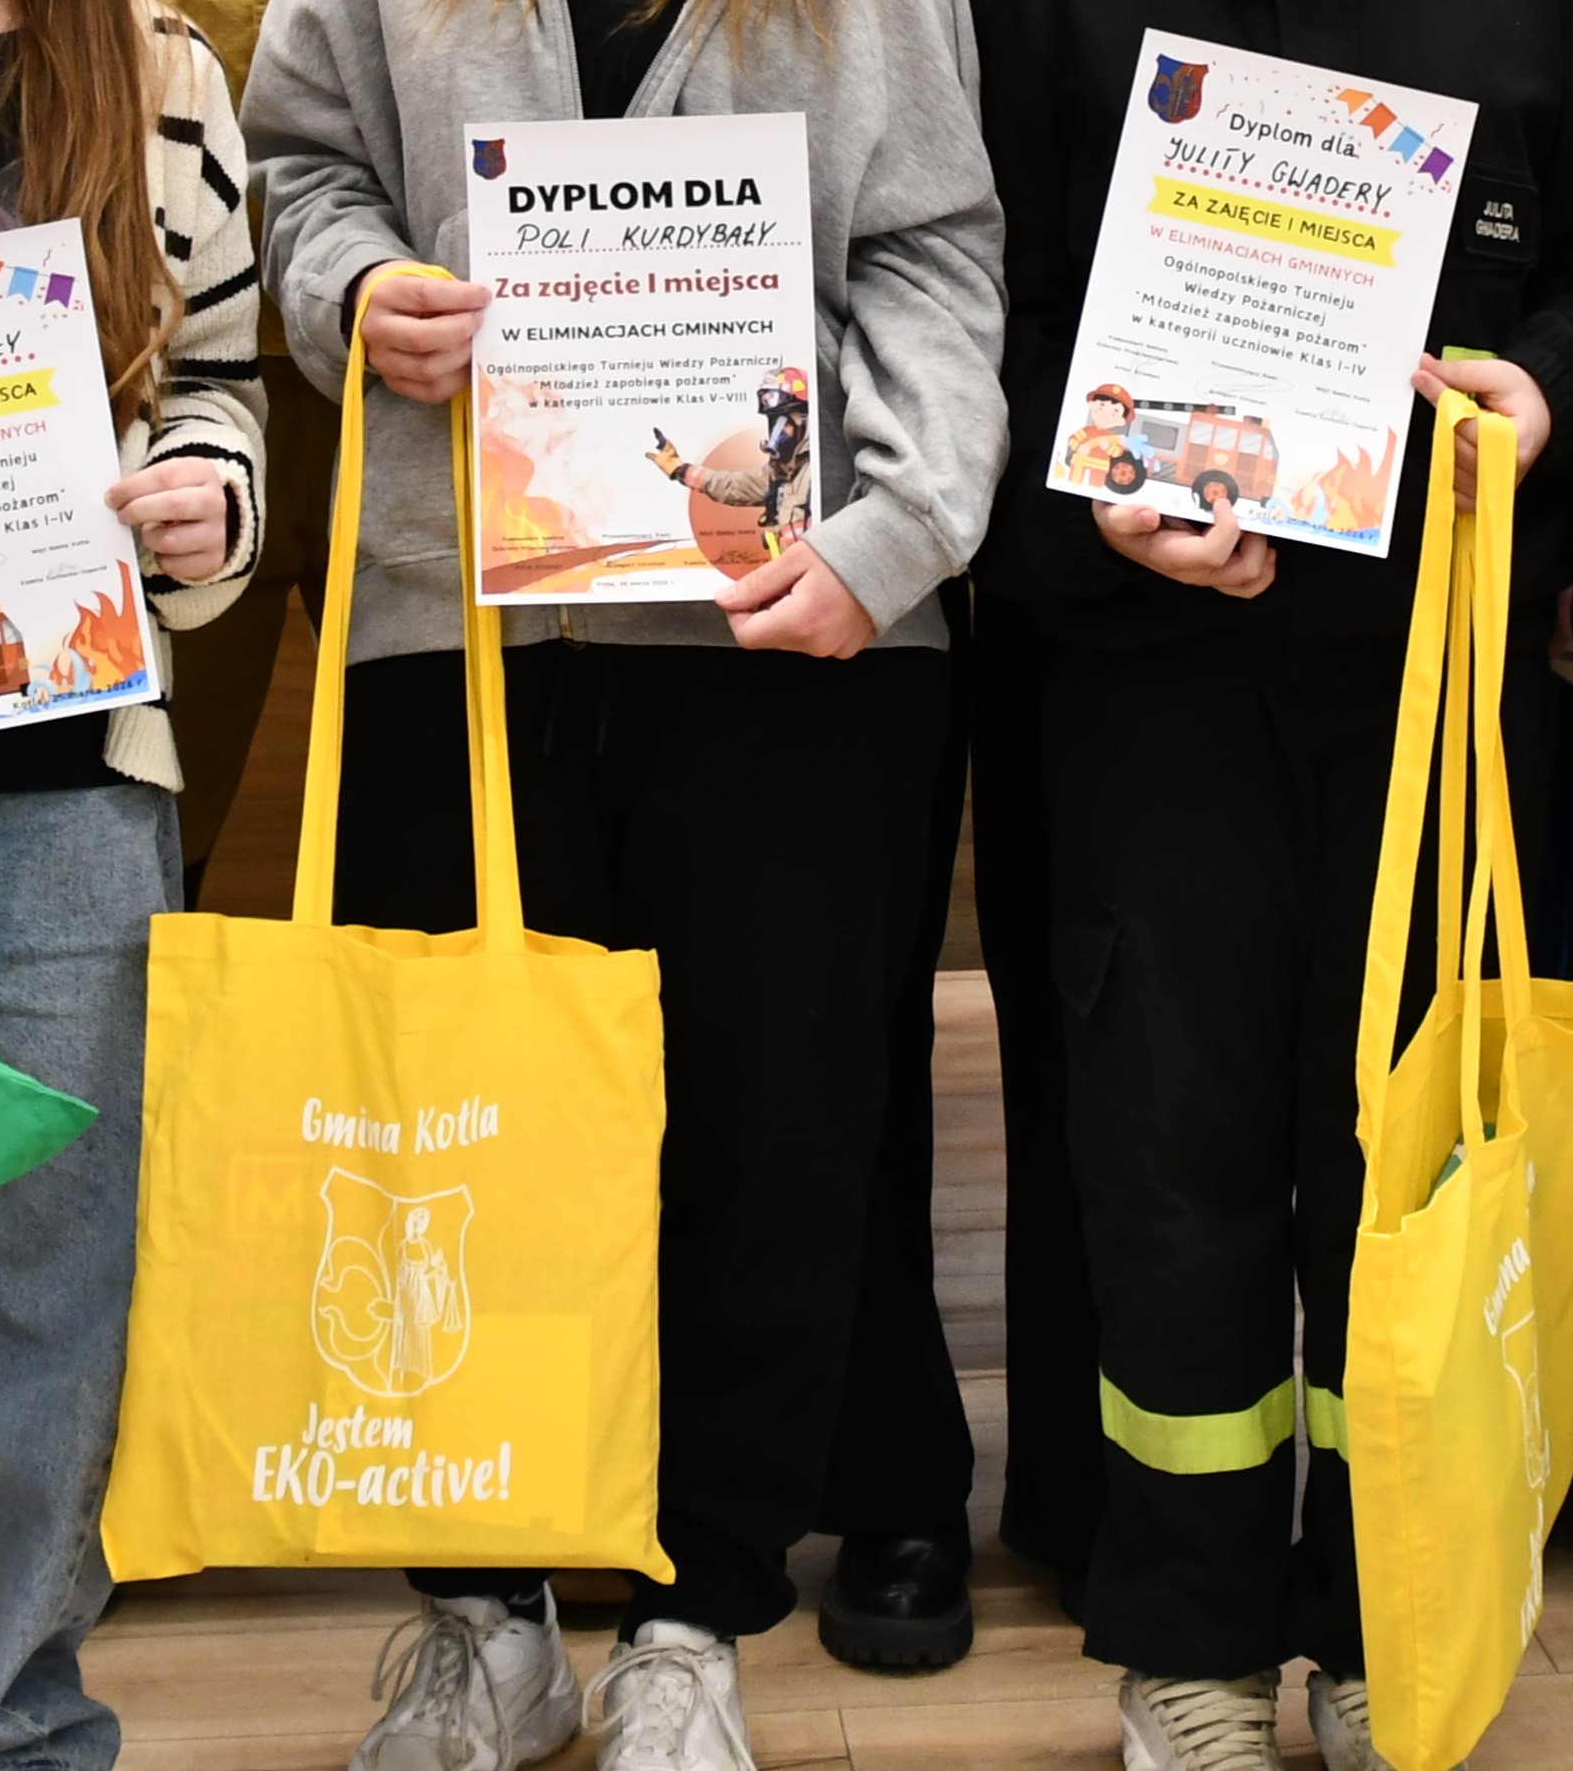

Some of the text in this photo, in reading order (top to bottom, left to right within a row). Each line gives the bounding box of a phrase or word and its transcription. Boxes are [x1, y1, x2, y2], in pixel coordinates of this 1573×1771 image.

[1229, 113, 1355, 158] Dyplom dla
[508, 178, 762, 214] DYPLOM DLA
[1271, 160, 1392, 210] GWADERY
[1172, 191, 1376, 251] ZA ZAJĘCIE I MIEJSCA
[1483, 200, 1515, 221] JULITA
[518, 220, 778, 250] POLI KURDYBAŁY
[1150, 225, 1164, 238] W
[1288, 257, 1375, 287] GMINNYCH
[495, 268, 779, 303] Za zajęcie I miejsca
[1163, 255, 1355, 311] Ogólnopolskiego Turnieju
[1184, 281, 1326, 327] Wiedzy Pożarniczej
[501, 320, 773, 342] W ELIMINACJACH GMINNYCH
[1132, 314, 1143, 324] w
[1148, 316, 1217, 341] kategorii
[1222, 335, 1294, 360] uczniowie
[1299, 351, 1332, 369] Klas
[1215, 312, 1290, 338] zapobiega
[486, 356, 786, 379] Ogólnopolskiego Turnieju Wiedzy Pożarniczej
[605, 377, 670, 390] zapobiega
[528, 398, 539, 408] w
[543, 398, 603, 409] kategorii
[608, 396, 670, 406] uczniowie
[676, 394, 705, 404] Klas
[4, 518, 39, 533] Klas
[301, 1095, 500, 1155] Gmina Kotla
[302, 1402, 413, 1451] Jestem
[252, 1441, 513, 1508] EKO-active!
